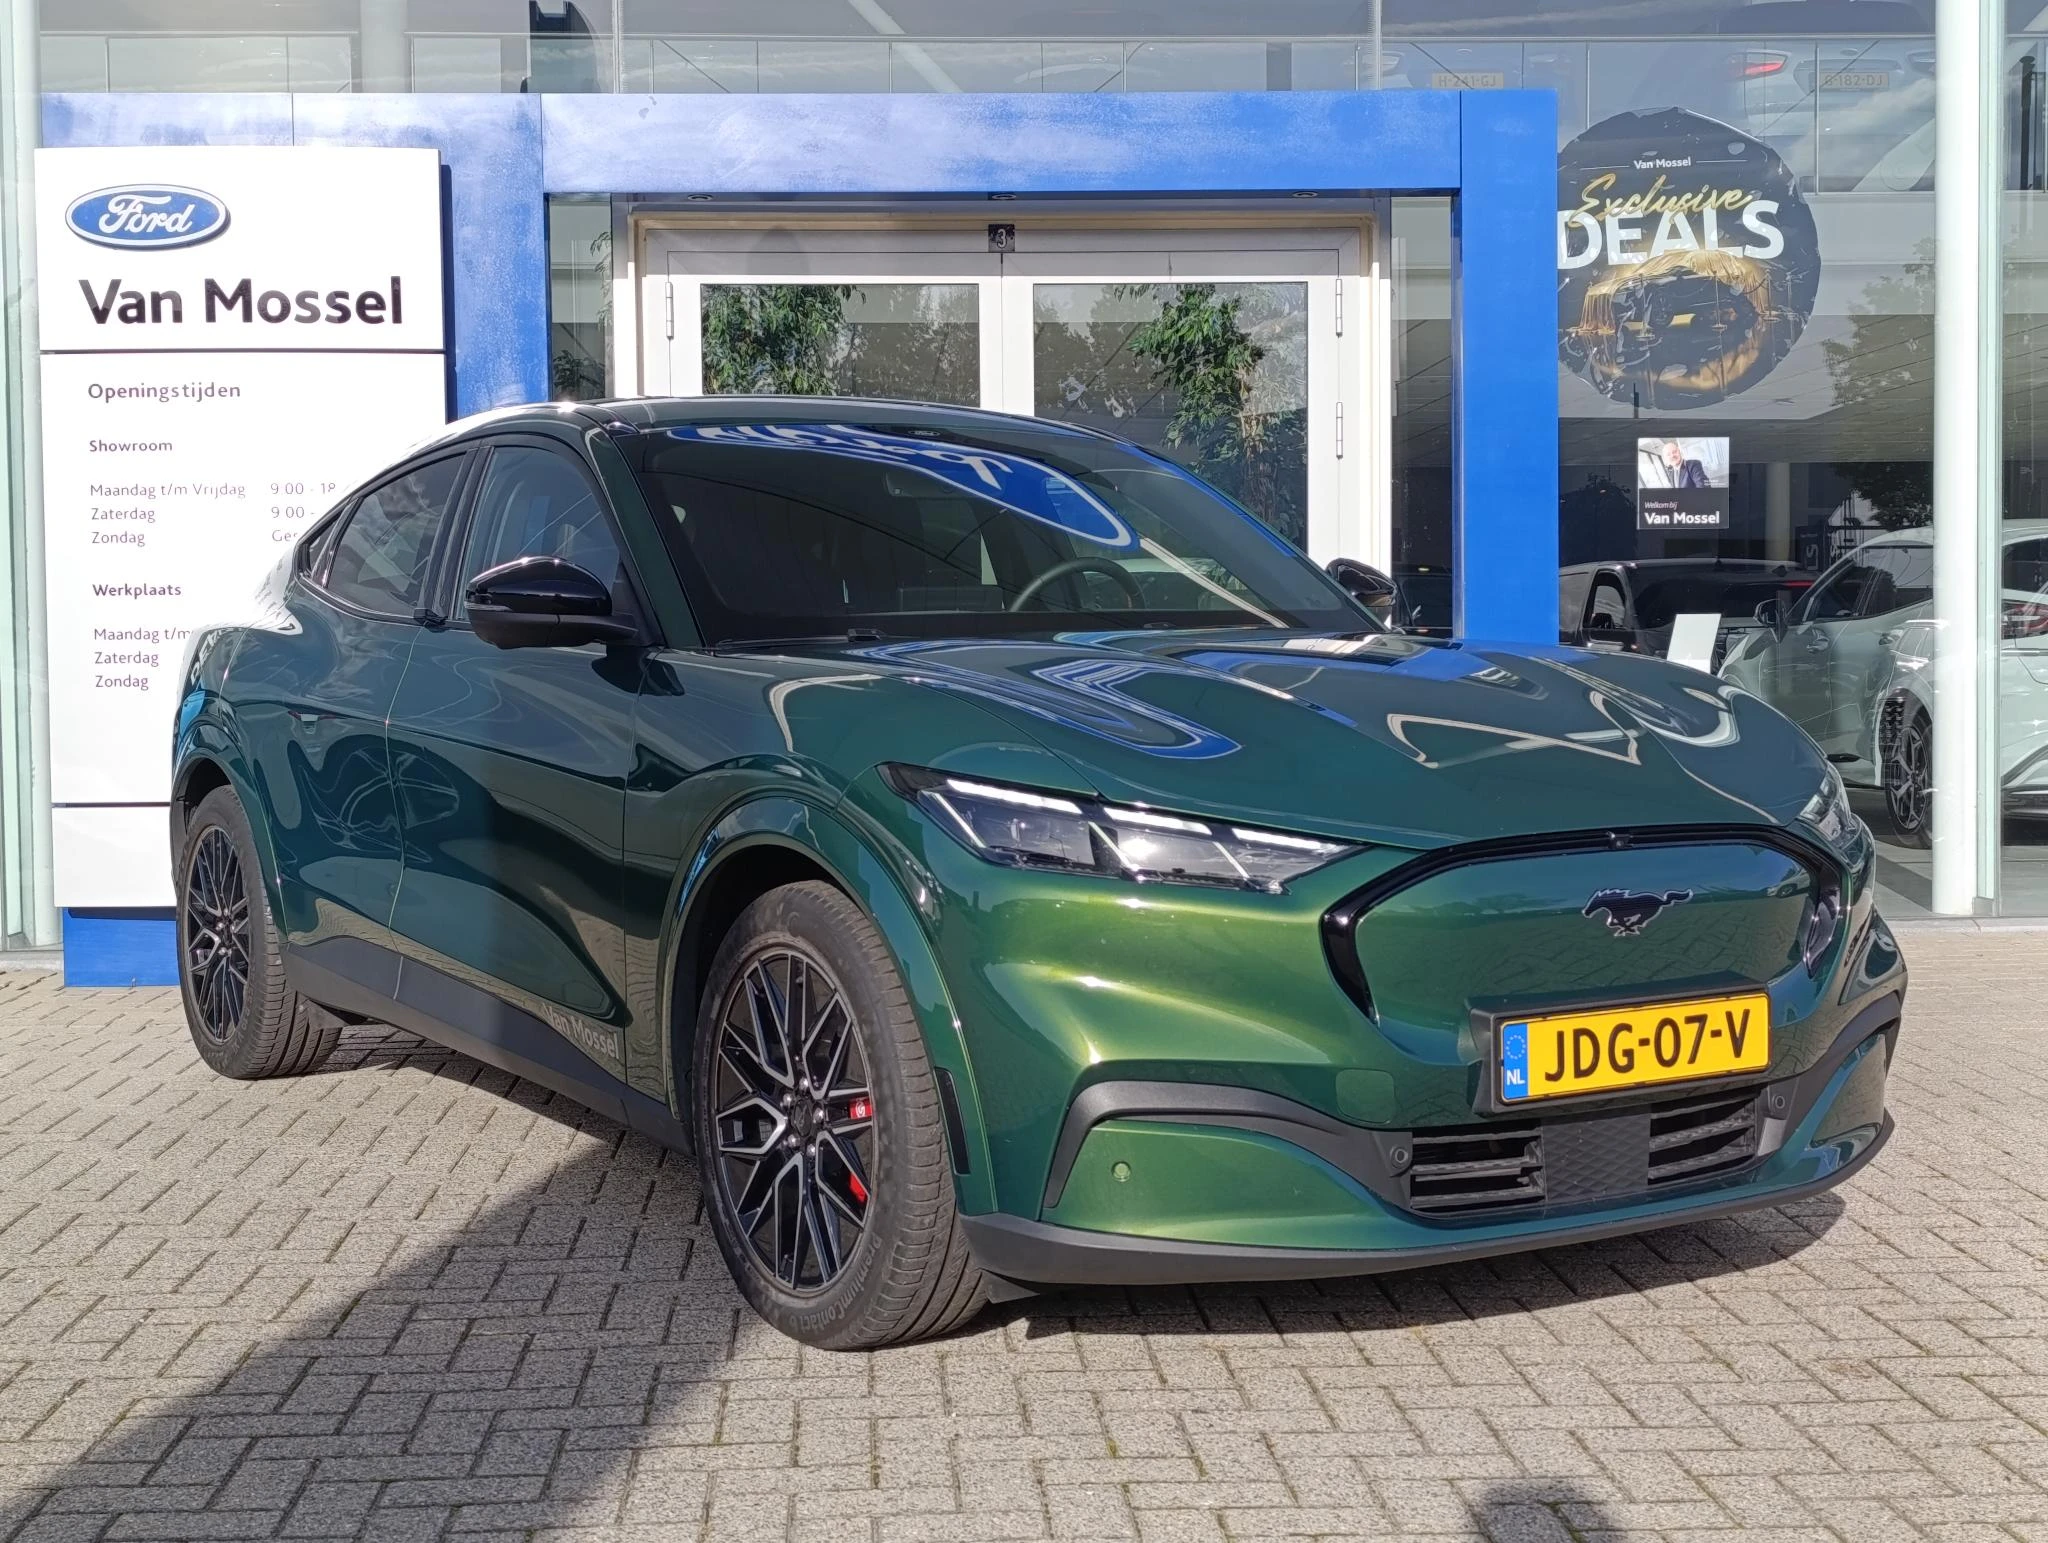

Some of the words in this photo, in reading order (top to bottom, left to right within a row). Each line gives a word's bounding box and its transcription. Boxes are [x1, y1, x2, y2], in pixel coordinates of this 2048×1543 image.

[1633, 159, 1653, 169] Van
[1655, 157, 1692, 168] Mossel
[1568, 173, 1753, 227] Exclusive
[98, 194, 195, 235] Ford
[996, 228, 1008, 249] 3
[1557, 200, 1785, 269] DEALS
[78, 279, 183, 324] Van
[204, 276, 403, 324] Mossel
[88, 382, 241, 403] Openingstijden
[89, 439, 173, 453] Showroom
[90, 484, 156, 499] Maandag
[161, 483, 188, 496] t/m
[193, 483, 246, 499] Vrijdag
[1644, 501, 1669, 509] Welkom
[1669, 501, 1678, 511] bij
[90, 507, 156, 523] Zaterdag
[1644, 512, 1670, 525] Van
[1673, 511, 1720, 524] Mossel
[91, 531, 146, 547] Zondag
[92, 583, 182, 600] Werkplaats
[94, 628, 160, 644] Maandag
[164, 627, 191, 641] t/m
[94, 651, 160, 667] Zaterdag
[95, 674, 150, 691] Zondag
[571, 1015, 620, 1060] Mossel
[1545, 1008, 1751, 1083] JDG-07-V
[1506, 1069, 1526, 1086] NL
